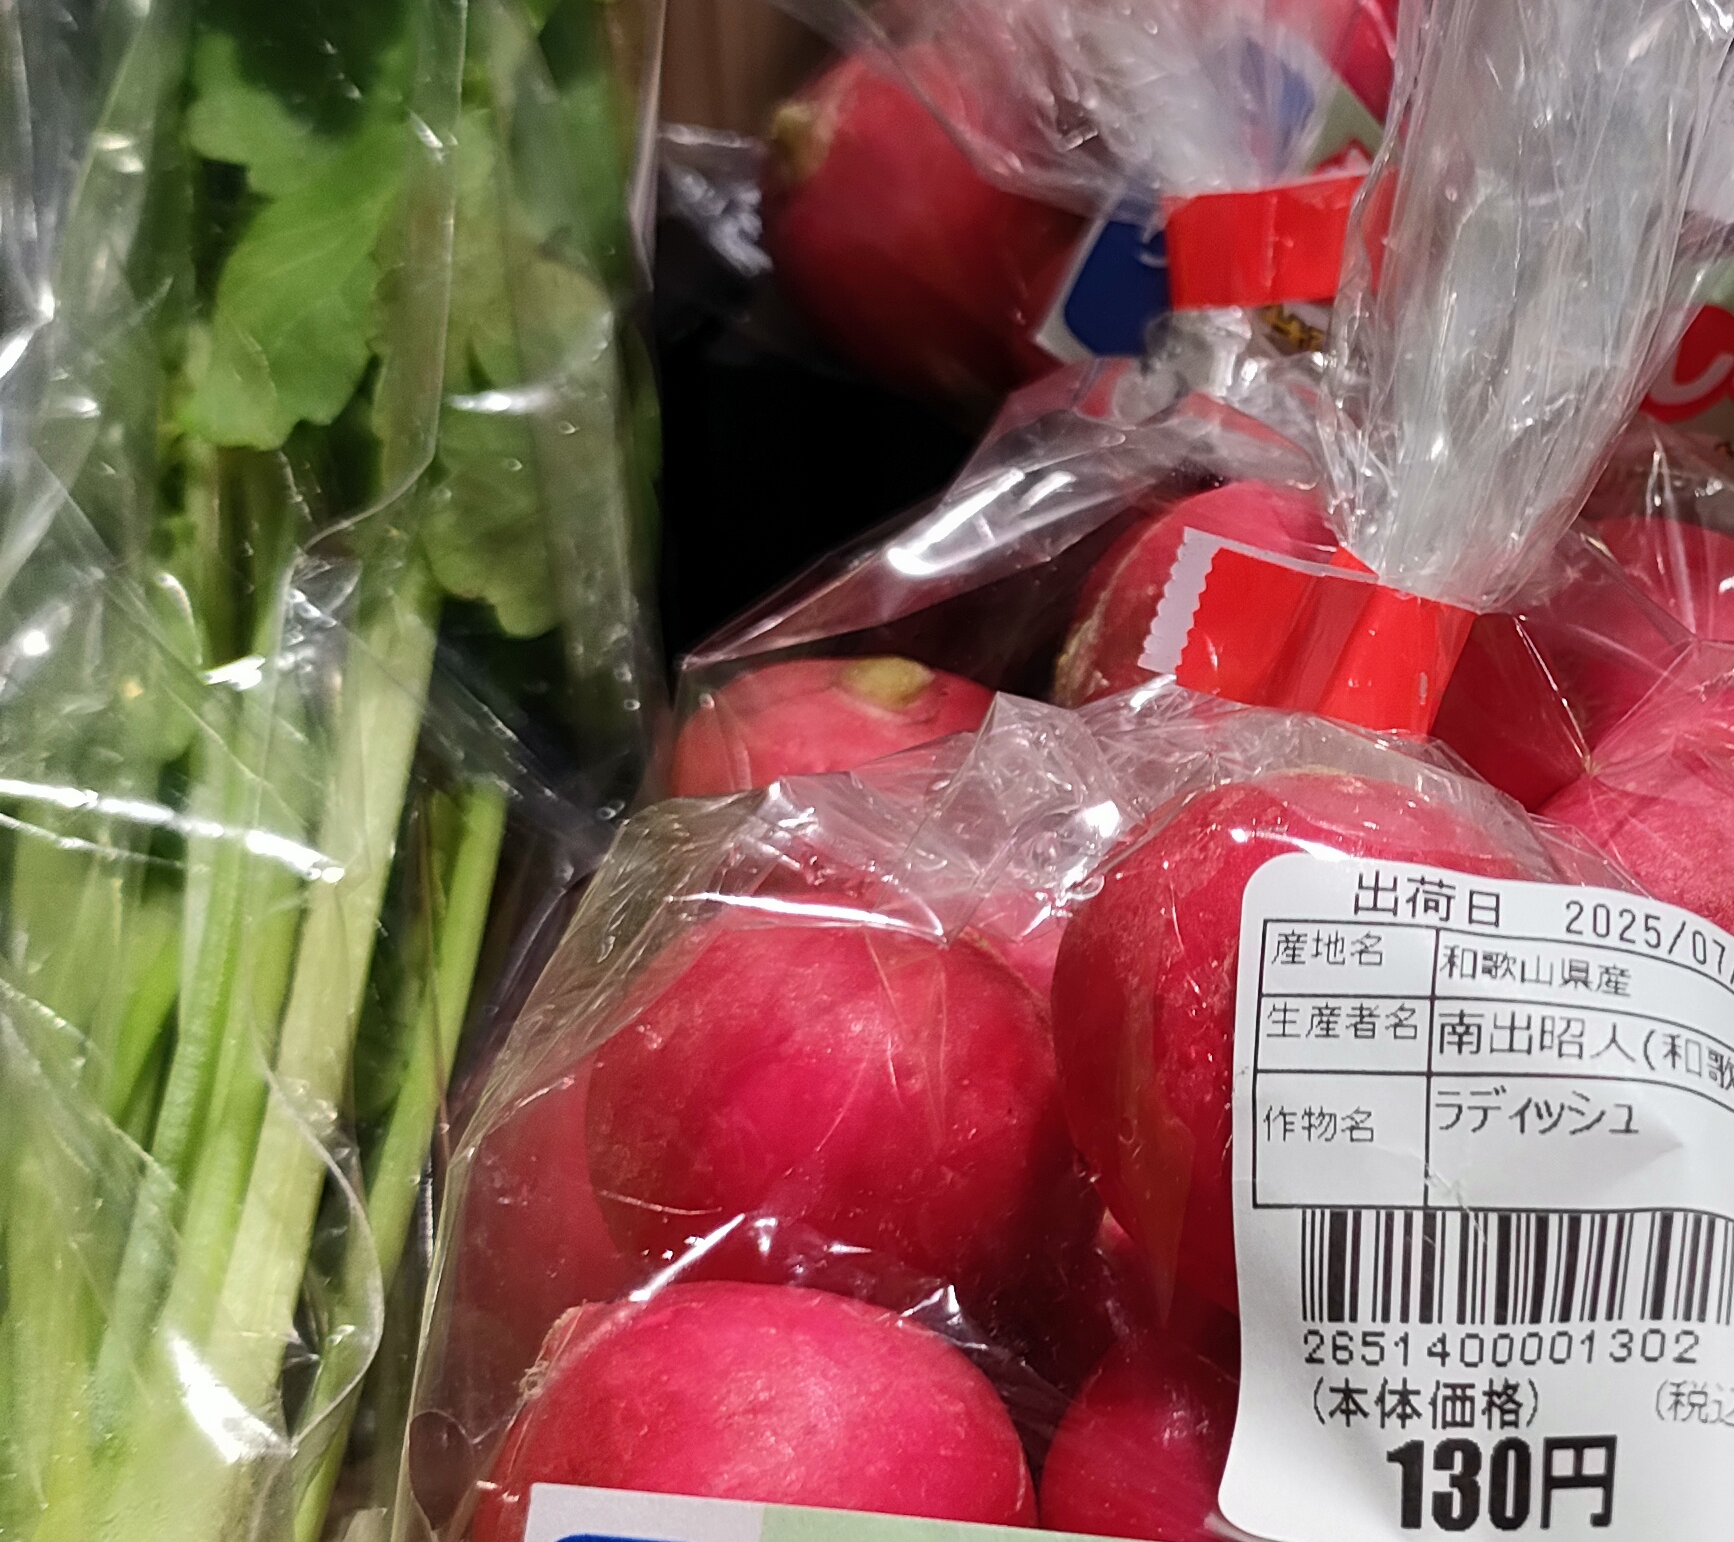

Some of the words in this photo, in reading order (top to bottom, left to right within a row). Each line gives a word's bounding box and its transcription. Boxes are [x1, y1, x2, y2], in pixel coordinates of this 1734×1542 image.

[1352, 869, 1503, 928] 出荷日
[1270, 928, 1385, 969] 産地名
[1438, 941, 1634, 1000] 和歌山県産
[1264, 1002, 1420, 1042] 生産者名
[1262, 1104, 1376, 1146] 作物名
[1301, 1327, 1701, 1368] 2651400001302
[1312, 1377, 1540, 1432] (本体価格)
[1386, 1434, 1618, 1533] 130円
